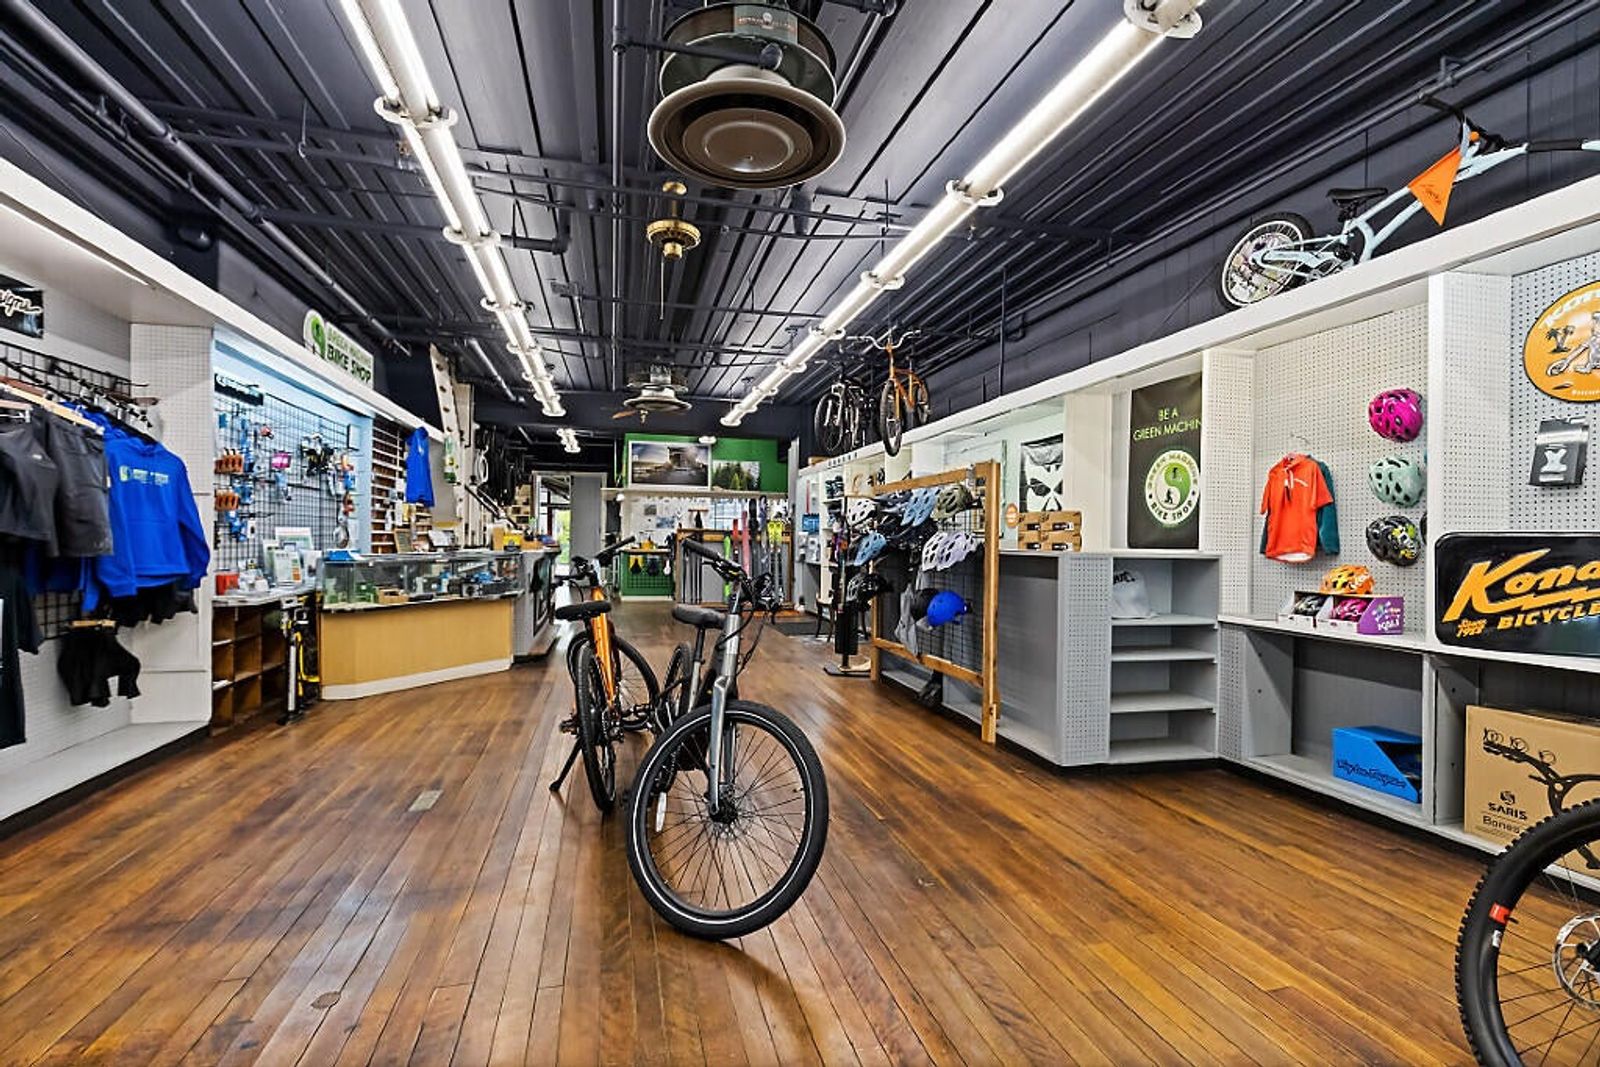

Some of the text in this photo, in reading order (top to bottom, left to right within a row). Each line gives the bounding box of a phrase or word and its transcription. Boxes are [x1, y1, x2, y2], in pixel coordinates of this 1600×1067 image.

[327, 343, 372, 383] BIKE SHOP
[1157, 407, 1178, 421] BE A
[1133, 427, 1161, 441] GREEN
[1150, 499, 1193, 520] BIKE SHOP
[1442, 548, 1600, 622] Kona
[1488, 802, 1527, 820] SARIS
[1483, 816, 1519, 833] Bones
